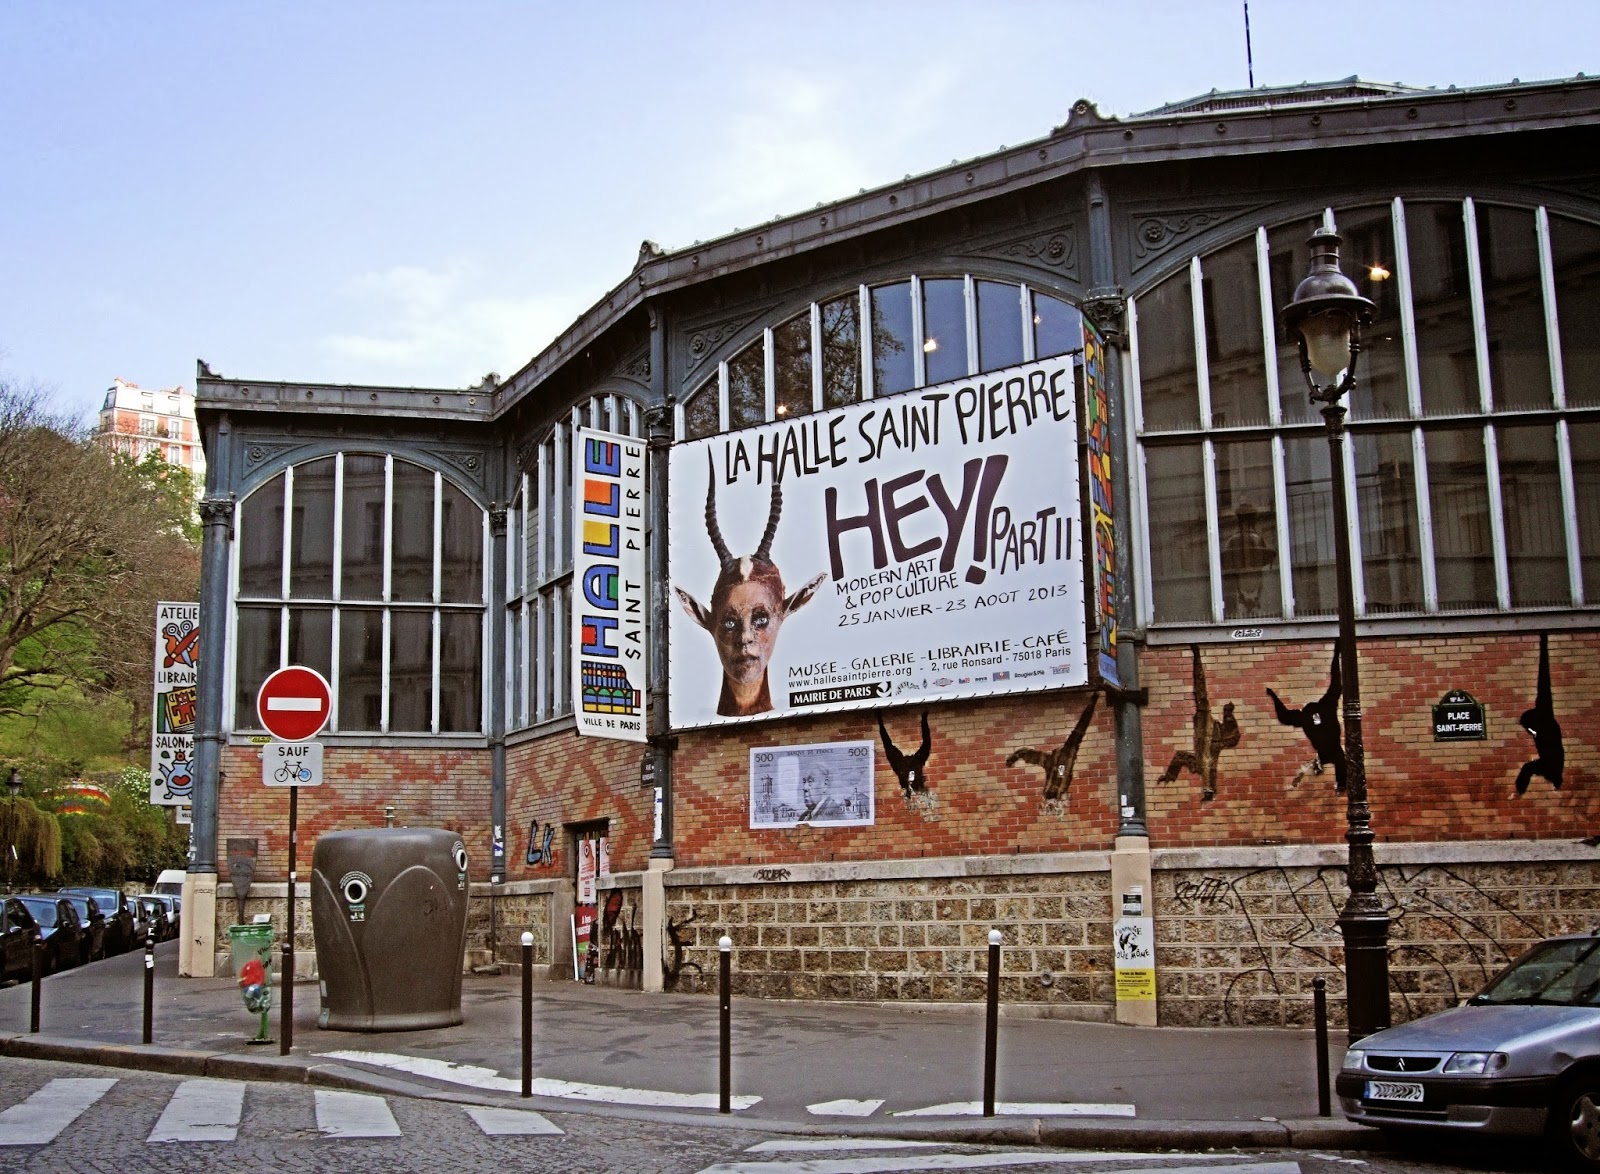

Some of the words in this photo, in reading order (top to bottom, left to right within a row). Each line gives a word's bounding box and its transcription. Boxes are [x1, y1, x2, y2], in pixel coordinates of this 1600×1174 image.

[725, 438, 752, 485] LA
[757, 415, 848, 484] HALLE
[858, 393, 950, 463] SAINT
[955, 368, 1071, 445] PIERRE
[625, 445, 641, 551] PIERRE
[825, 454, 1009, 585] HEY!
[580, 437, 621, 659] HALLE
[991, 506, 1056, 575] PART
[1056, 517, 1072, 560] II
[836, 567, 902, 595] MODERN
[906, 557, 937, 582] ART
[845, 595, 857, 609] &
[860, 586, 893, 606] POP
[896, 572, 959, 599] CULTURE
[625, 580, 641, 660] SAINT
[838, 613, 860, 627] 25
[863, 604, 933, 624] JANVIER
[946, 599, 966, 612] 23
[1028, 584, 1068, 601] 2013
[788, 661, 837, 678] MUSÉE
[851, 652, 916, 671] GALERIE
[928, 639, 1011, 661] LIBRAIRIE
[1022, 629, 1071, 648] CAFÉ
[788, 666, 912, 688] www.hallesaintpierre.org
[931, 661, 940, 672] 2,
[942, 660, 958, 670] rue
[962, 654, 1002, 668] Ronsard
[1013, 649, 1042, 662] 75018
[1045, 646, 1072, 658] Paris
[794, 690, 827, 704] MAIRIE
[829, 688, 842, 700] DE
[844, 686, 872, 699] PARIS
[583, 717, 603, 727] VILLE
[606, 719, 616, 729] DE
[620, 720, 641, 731] PARIS
[1436, 723, 1482, 732] SAINT-PIERRE
[1447, 712, 1470, 720] PLACE
[155, 736, 185, 749] SALON
[278, 746, 310, 757] SAUF
[755, 753, 774, 763] 500
[848, 747, 868, 757] 500
